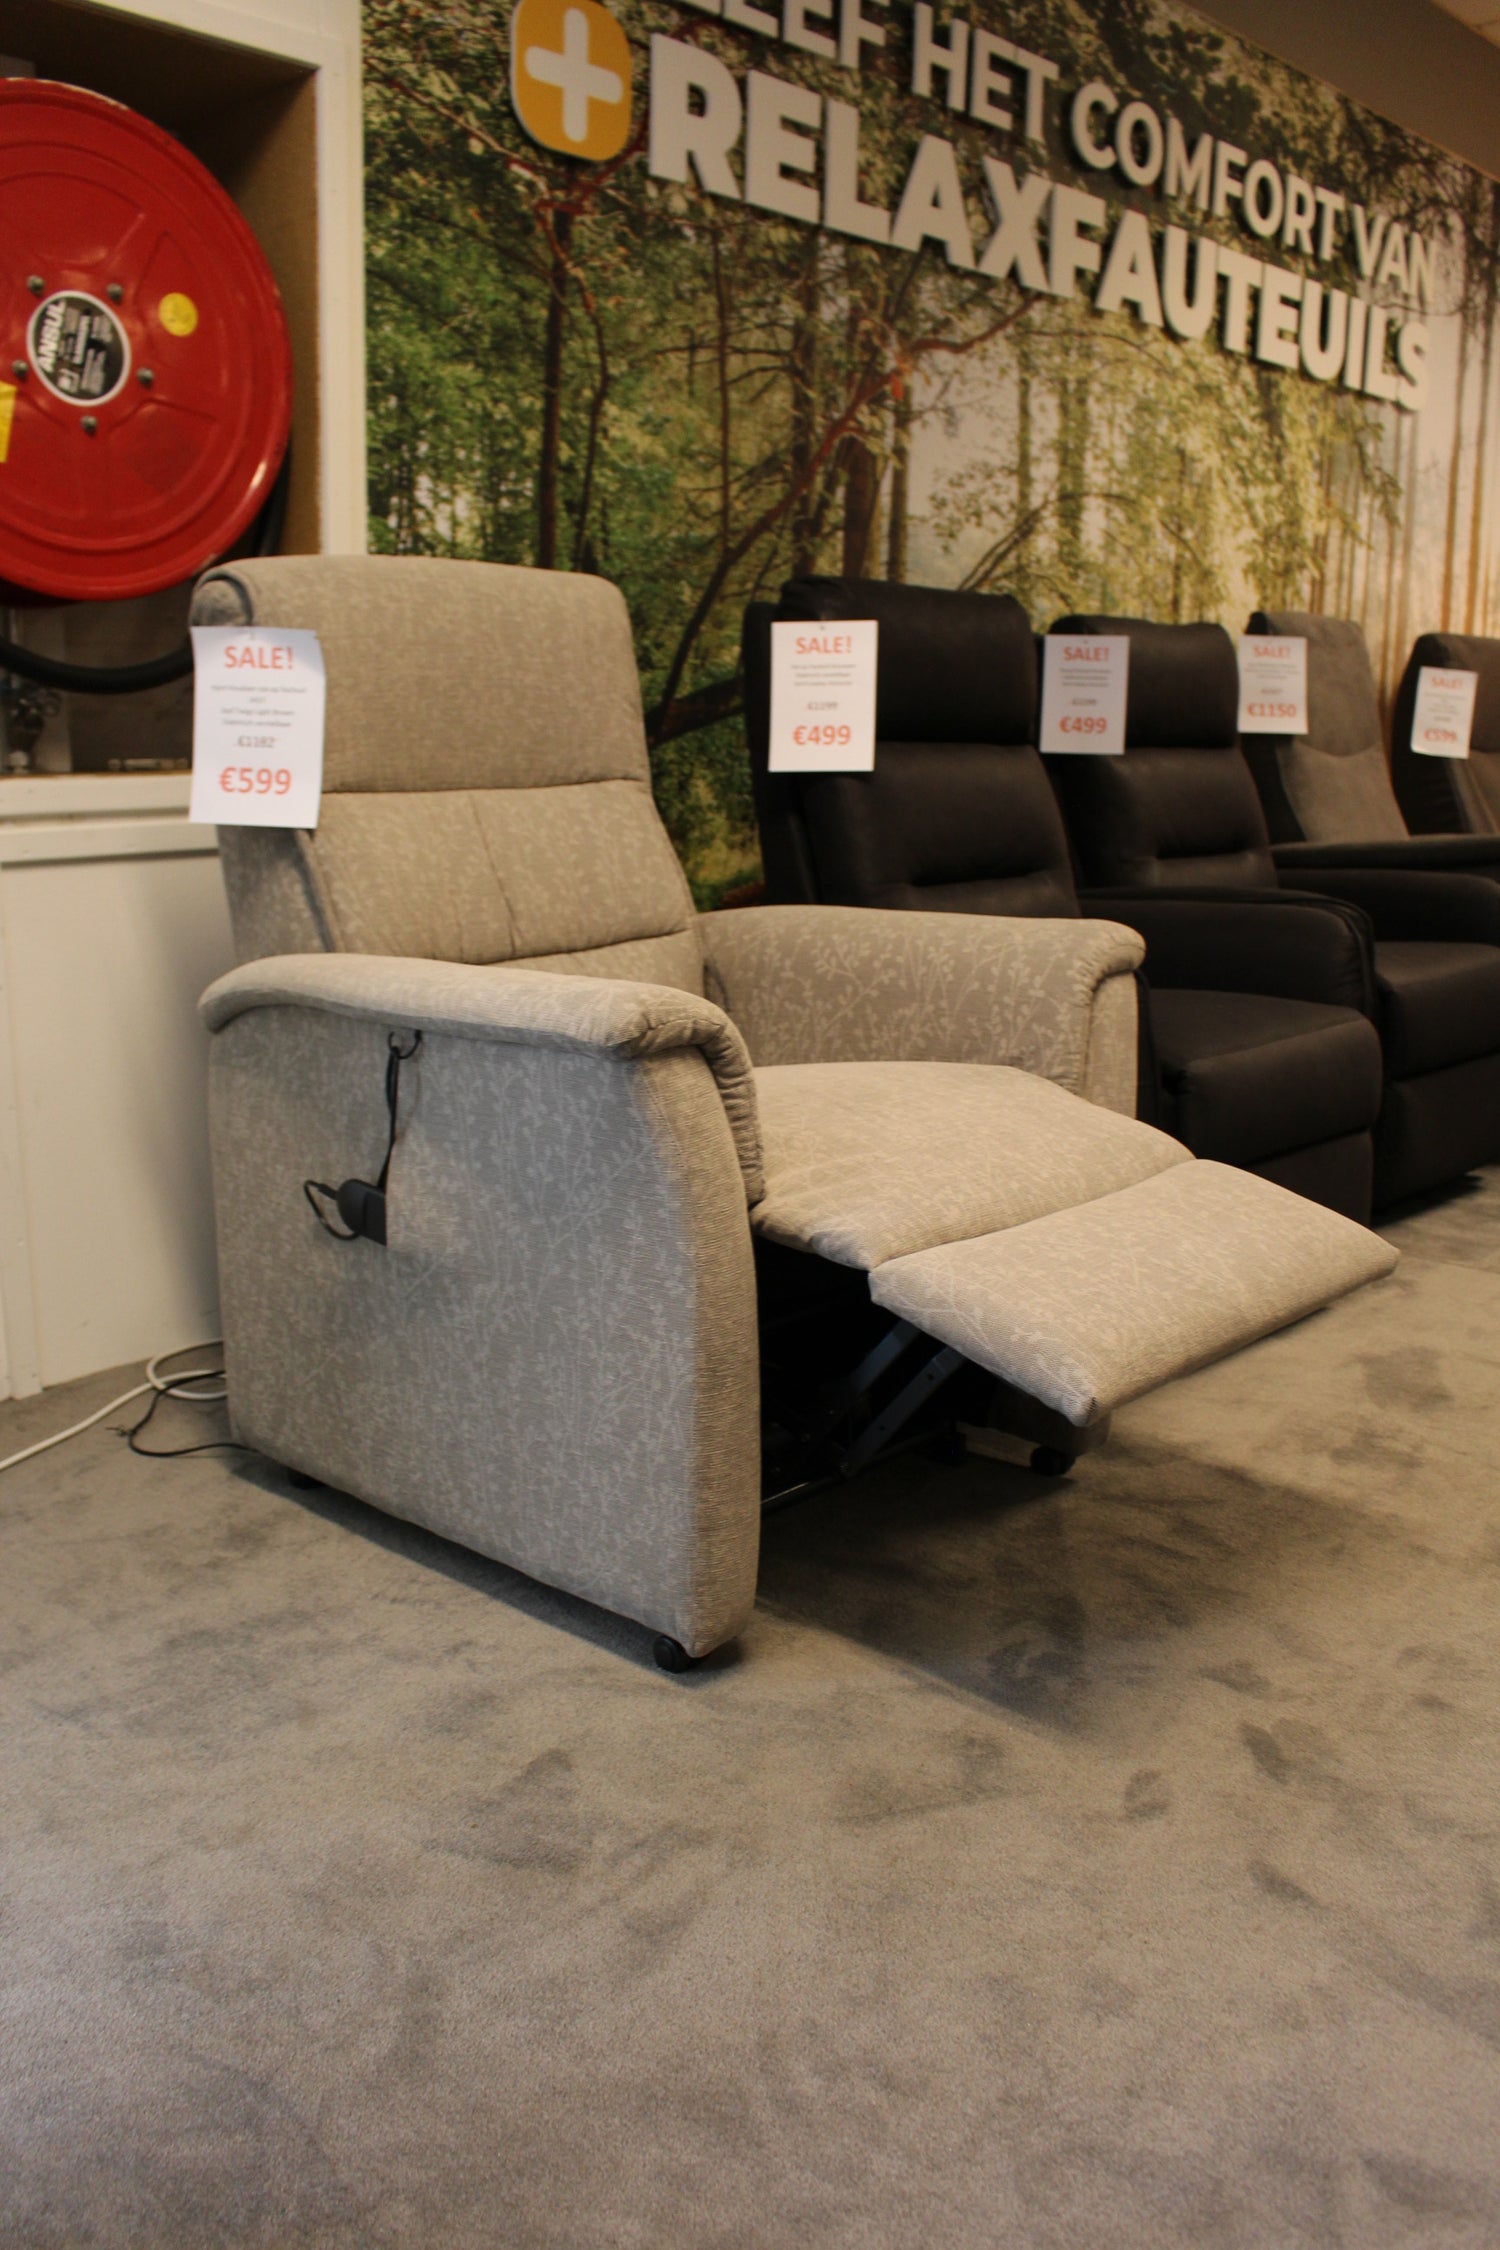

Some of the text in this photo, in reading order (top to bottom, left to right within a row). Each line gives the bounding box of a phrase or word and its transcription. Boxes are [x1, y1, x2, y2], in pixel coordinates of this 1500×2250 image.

[911, 2, 1059, 142] HET
[1071, 82, 1345, 261] COMFORT
[1352, 203, 1436, 302] VAN
[648, 32, 1431, 411] RELAXFAUTEUILS
[796, 635, 852, 654] SALE!
[1063, 646, 1109, 662] SALE!
[224, 645, 294, 669] SALE!
[1247, 702, 1297, 718] €1150
[793, 725, 852, 746] €499
[1059, 716, 1108, 735] €499
[219, 766, 293, 795] €599
